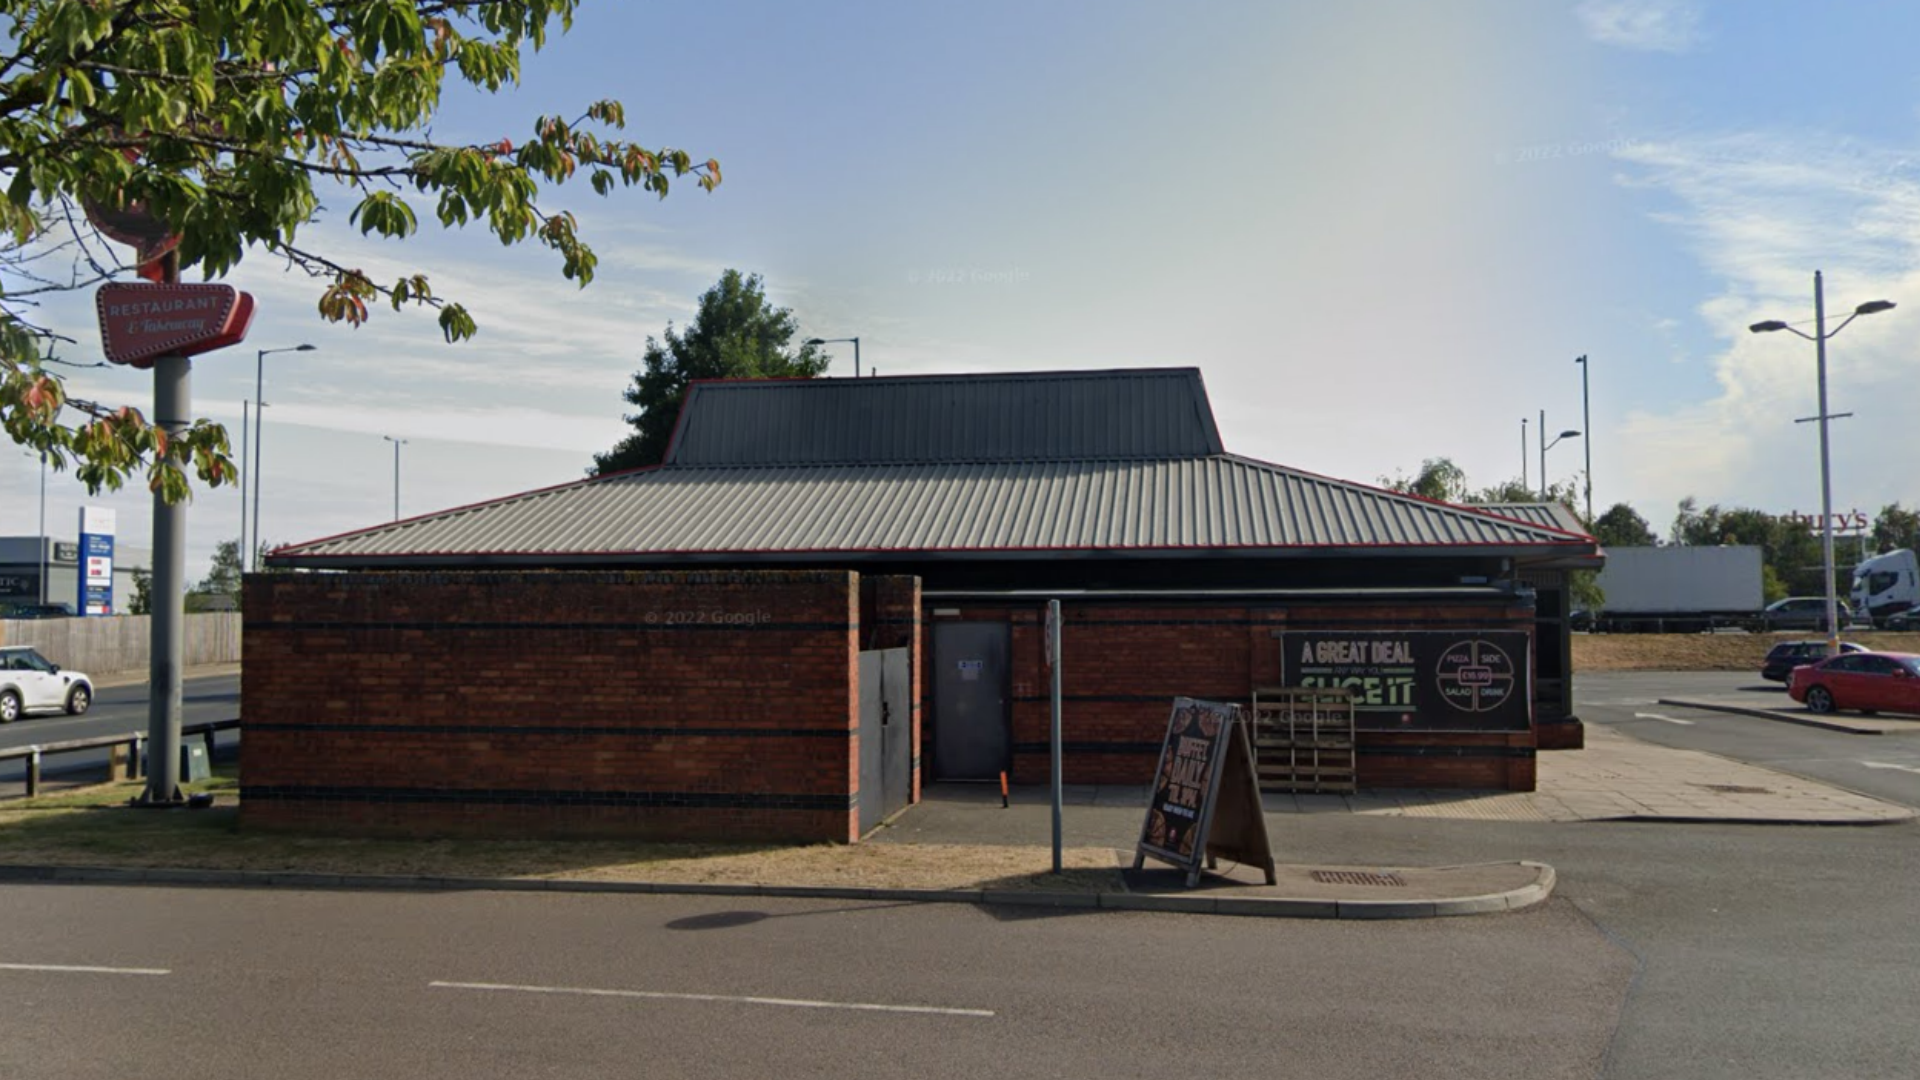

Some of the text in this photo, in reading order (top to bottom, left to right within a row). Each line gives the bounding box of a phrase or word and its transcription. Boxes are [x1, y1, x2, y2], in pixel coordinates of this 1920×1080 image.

[109, 296, 218, 317] RESTAURANT
[1301, 640, 1415, 664] A GREAT DEAL
[1446, 654, 1470, 664] PIZZA
[1480, 654, 1502, 664] SIDE
[1301, 677, 1416, 705] SLICE IT
[1445, 687, 1472, 697] SALAD
[1480, 687, 1505, 697] DRINK
[1171, 755, 1206, 788] DAILY
